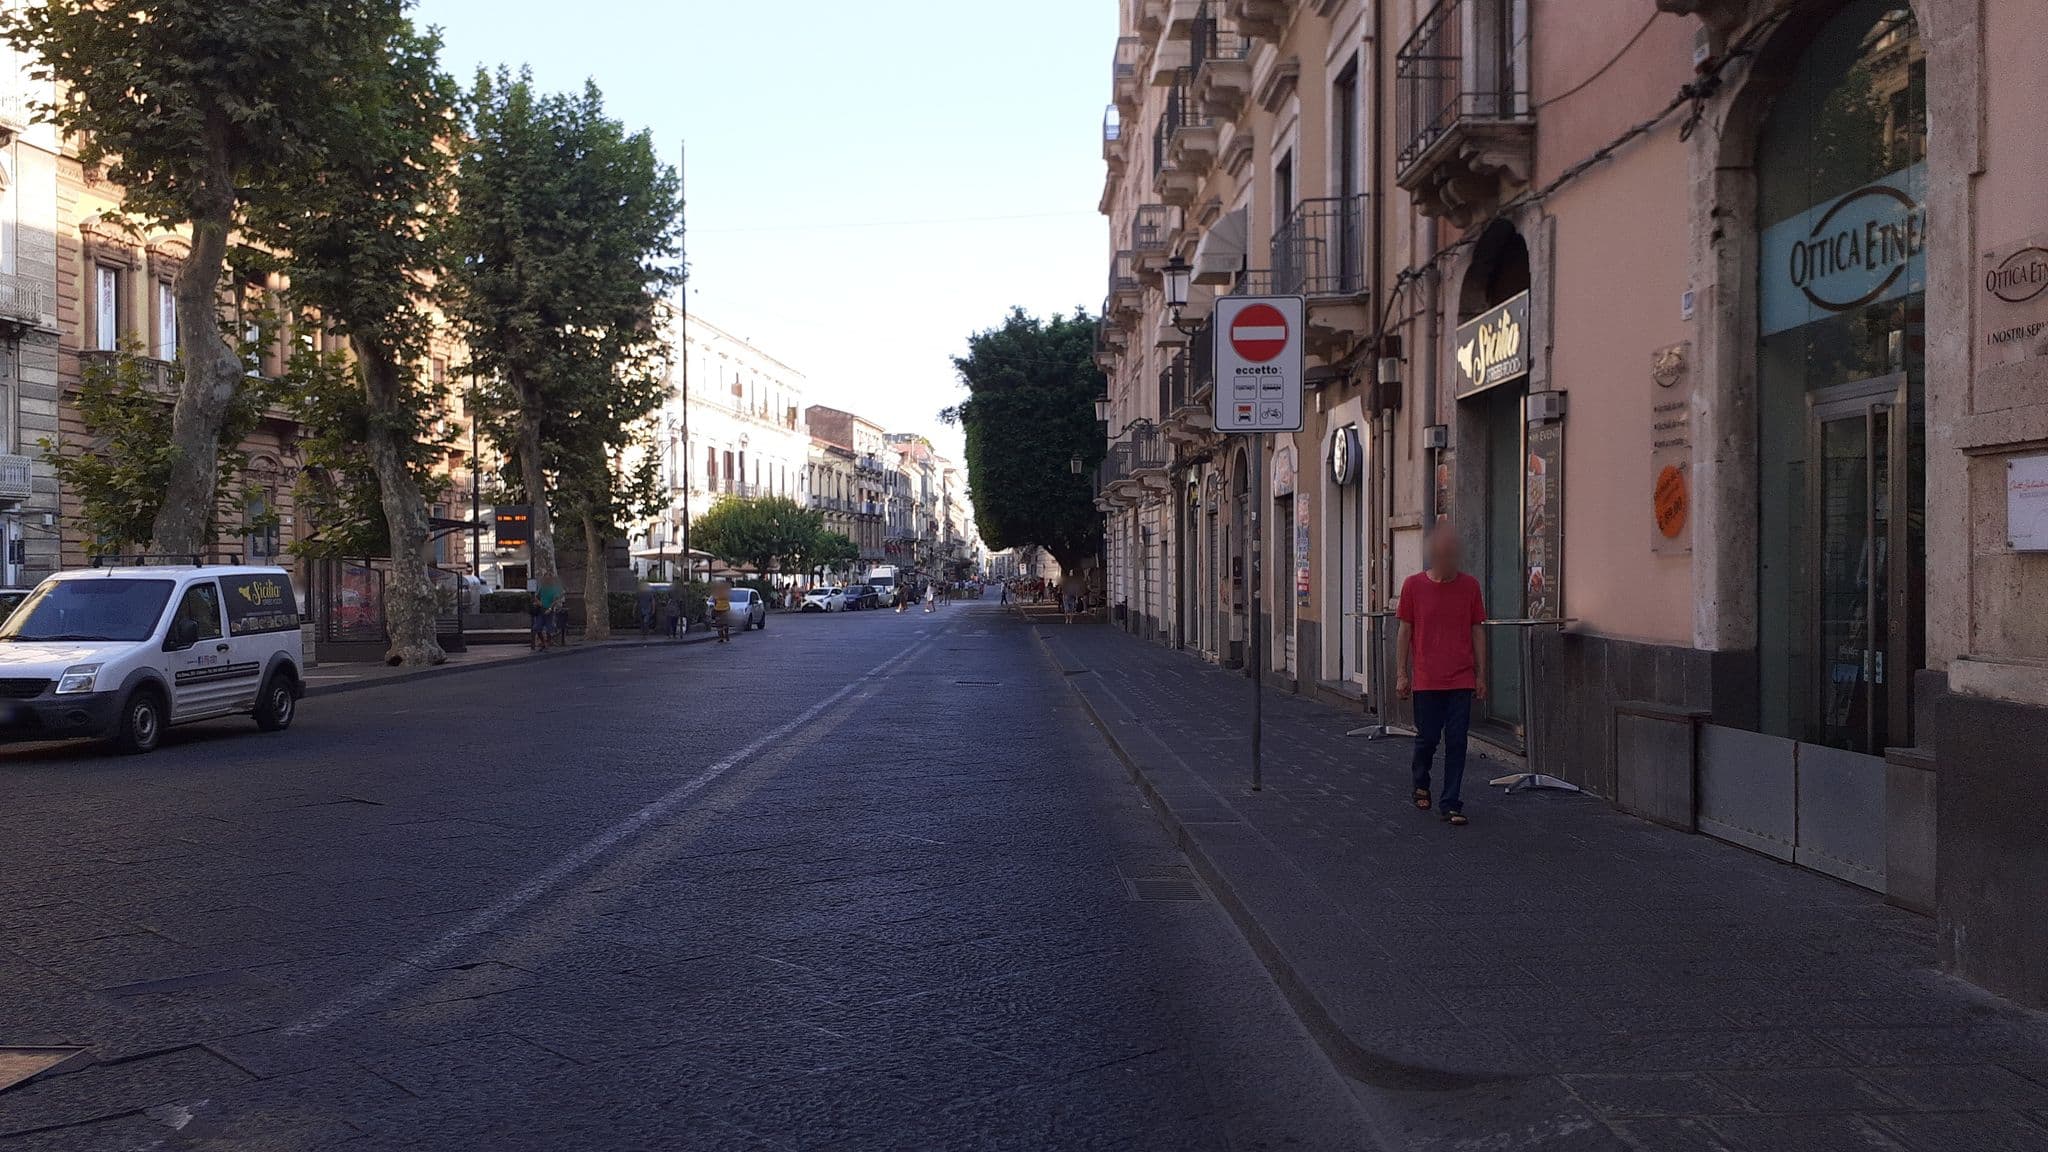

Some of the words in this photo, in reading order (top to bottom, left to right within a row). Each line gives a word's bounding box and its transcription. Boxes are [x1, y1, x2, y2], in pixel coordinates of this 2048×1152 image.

[1790, 229, 1861, 287] OTTICA
[1986, 265, 2028, 292] OTTICA
[252, 579, 281, 606] Sicilia
